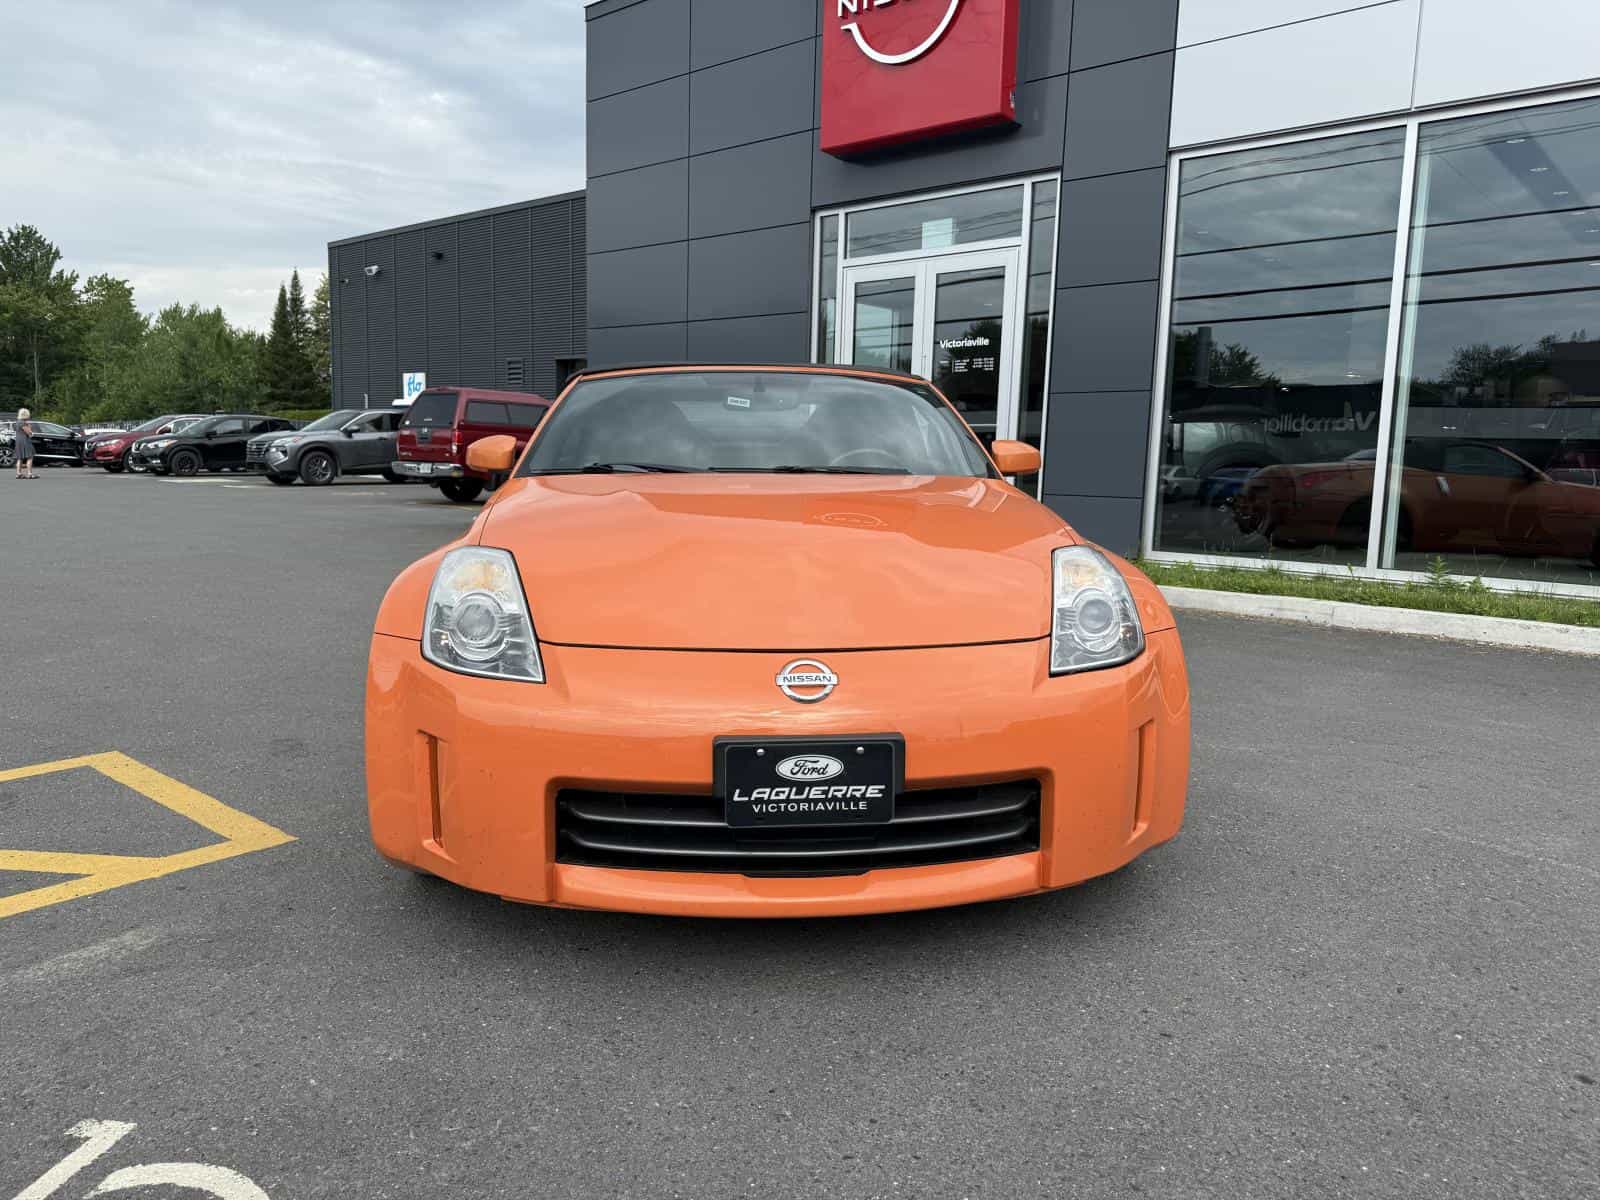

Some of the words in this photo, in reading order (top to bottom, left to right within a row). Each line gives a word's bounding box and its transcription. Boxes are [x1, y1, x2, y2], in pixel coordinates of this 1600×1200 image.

[939, 337, 990, 349] Victoriaville
[407, 375, 423, 397] flo
[782, 674, 832, 683] NISSAN
[790, 758, 829, 777] Ford
[733, 785, 886, 802] LAQUERRE
[752, 801, 868, 813] VICTORIAVILLE
